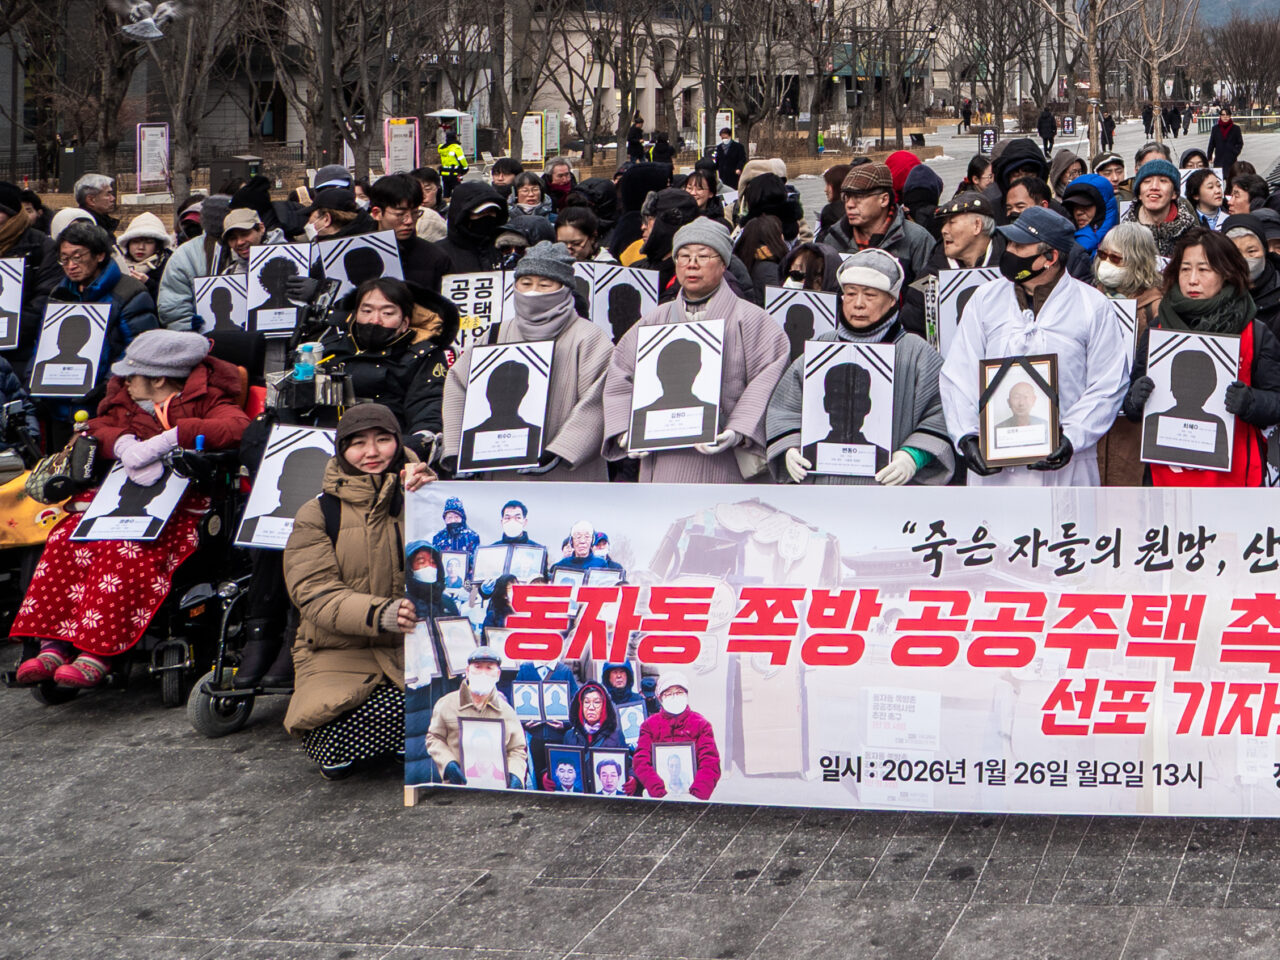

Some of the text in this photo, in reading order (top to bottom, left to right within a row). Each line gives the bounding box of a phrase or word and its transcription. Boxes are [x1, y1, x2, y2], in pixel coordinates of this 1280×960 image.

[450, 277, 493, 301] 공공
[1008, 522, 1122, 577] 자들의
[1134, 525, 1226, 577] 원망,
[504, 585, 715, 665] 동자동
[727, 587, 882, 667] 쪽방
[890, 589, 1207, 672] 공공주택
[1041, 679, 1157, 735] 선포
[819, 756, 862, 783] 일시
[882, 758, 966, 785] 2026년
[974, 759, 1006, 786] 1월
[1014, 759, 1068, 787] 26일
[1076, 760, 1144, 788] 월요일
[1152, 761, 1203, 789] 13시
